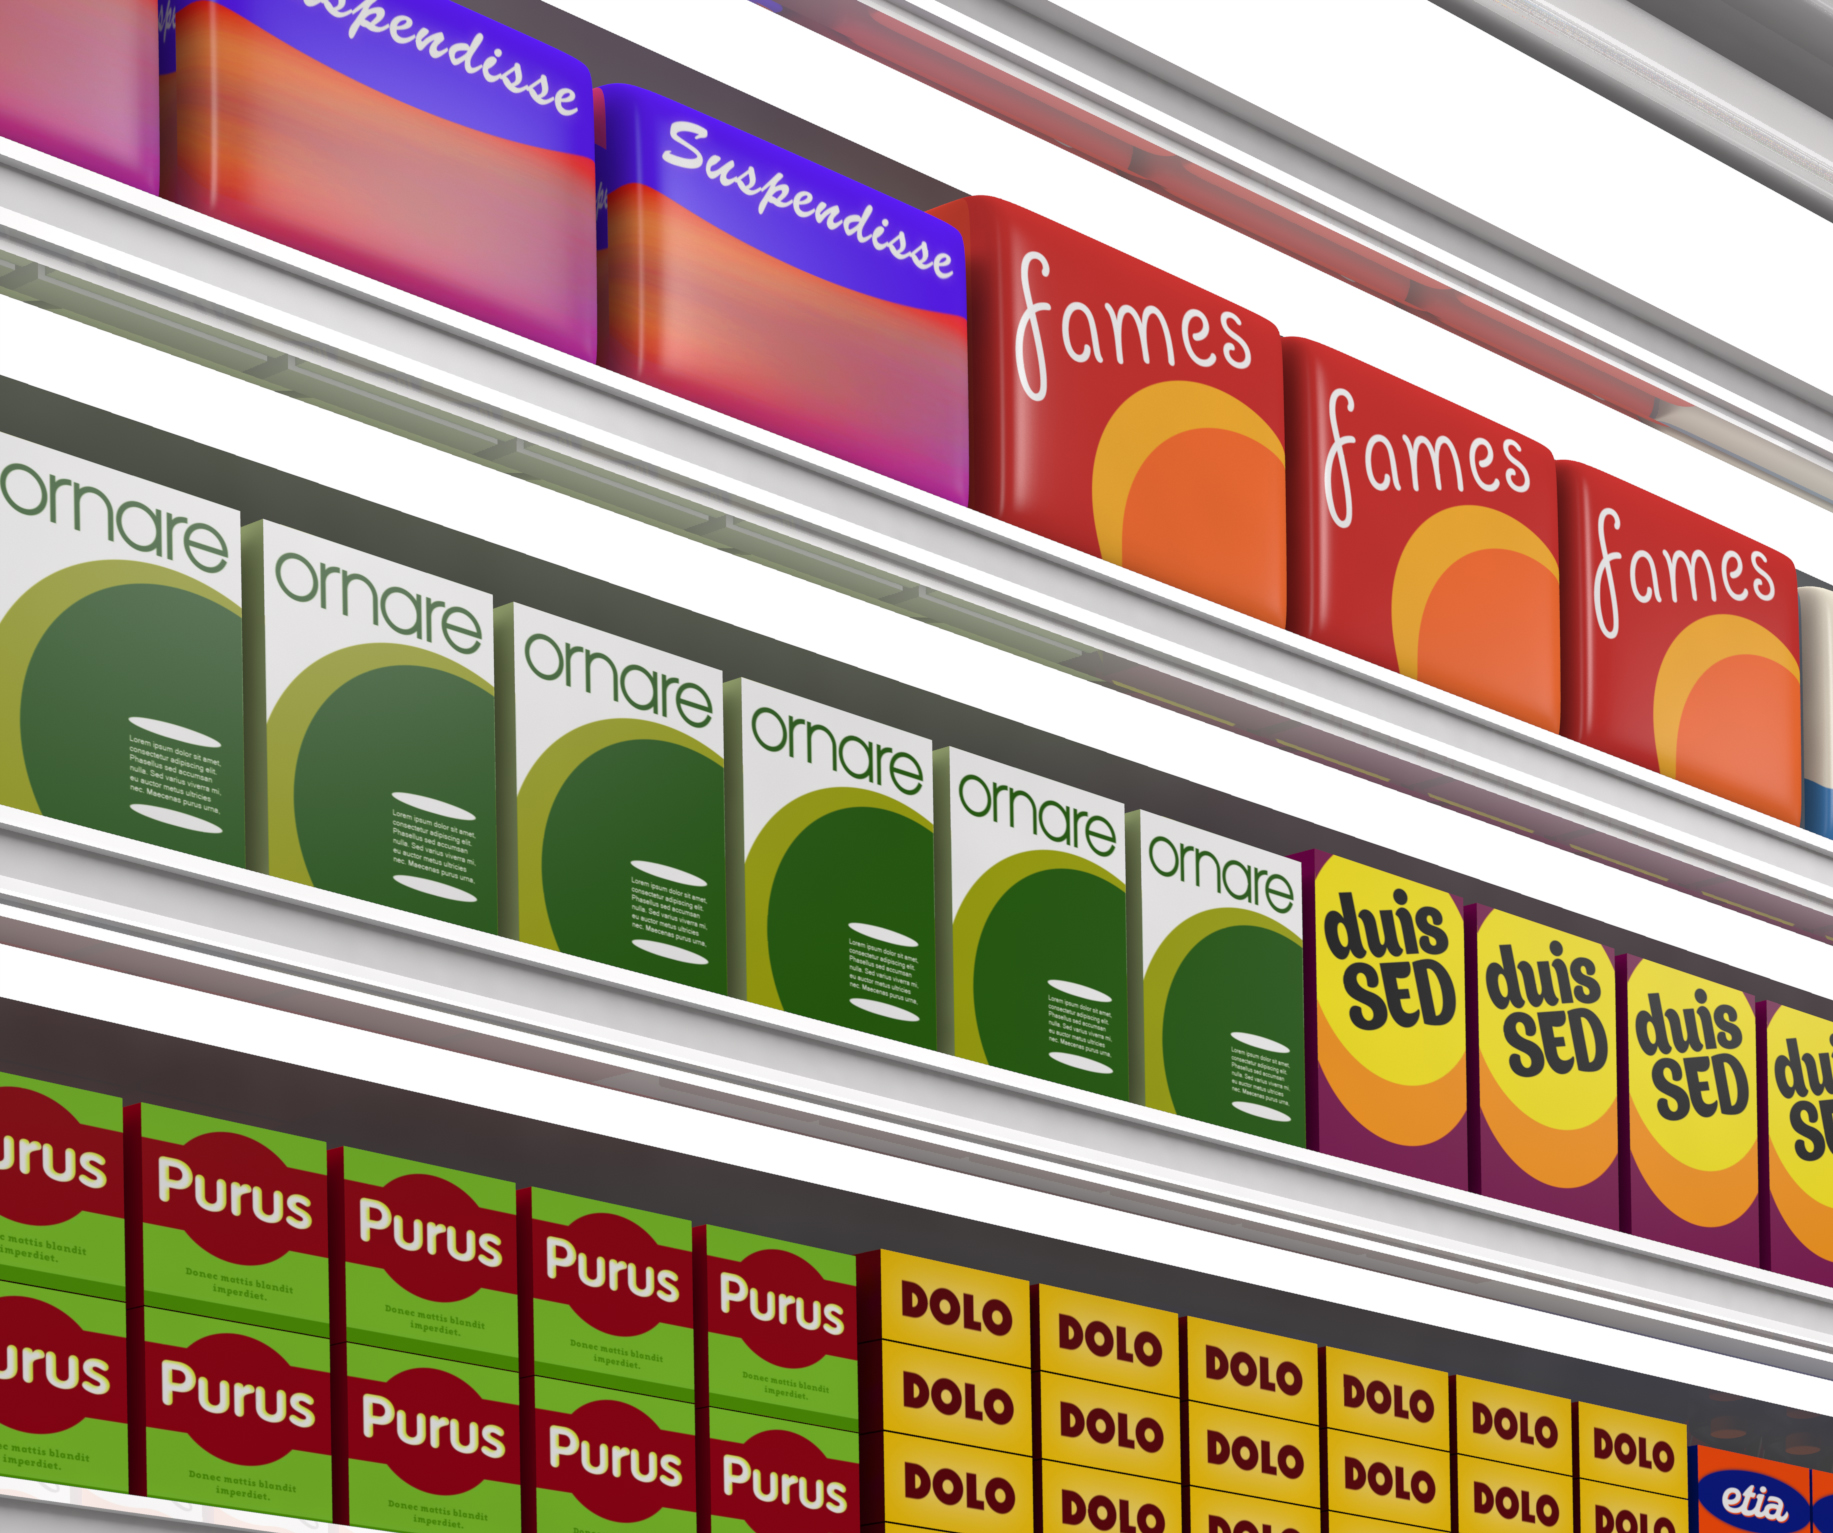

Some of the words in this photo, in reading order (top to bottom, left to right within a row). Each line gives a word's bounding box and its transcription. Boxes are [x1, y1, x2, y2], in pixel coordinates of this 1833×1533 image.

[660, 120, 955, 279] Suspendisse
[1015, 251, 1253, 402] fames
[1323, 388, 1531, 528] fames
[0, 461, 229, 574] ornare
[273, 551, 483, 655] ornare
[1593, 506, 1776, 639] fames
[523, 633, 714, 729] ornare
[129, 735, 151, 746] Lorem
[153, 741, 173, 753] ipsum
[175, 748, 192, 758] dolor
[129, 746, 169, 761] consectetur
[170, 757, 203, 772] adipiscing
[129, 754, 163, 769] Phasellus
[165, 765, 177, 773] sed
[750, 705, 923, 797] ornare
[959, 772, 1117, 858] ornare
[1148, 833, 1295, 914] ornare
[1323, 889, 1449, 962] duis
[1343, 958, 1457, 1031] SED
[1485, 940, 1602, 1010] duis
[1503, 1005, 1609, 1078] SED
[1635, 989, 1743, 1056] duis
[1651, 1052, 1750, 1122] SED
[158, 1155, 312, 1231] Purus
[359, 1197, 502, 1269] Purus
[185, 1267, 218, 1280] Donec
[221, 1273, 253, 1287] mattis
[256, 1280, 294, 1294] blandit
[212, 1284, 268, 1301] imperdiet.
[545, 1236, 680, 1302] Purus
[719, 1270, 845, 1337] Purus
[901, 1280, 1013, 1337] DOLO
[1058, 1313, 1162, 1368] DOLO
[160, 1359, 316, 1430] Purus
[1205, 1344, 1303, 1397] DOLO
[1342, 1373, 1434, 1424] DOLO
[362, 1392, 506, 1460] Purus
[1060, 1401, 1164, 1454] DOLO
[1721, 1481, 1788, 1524] etia
